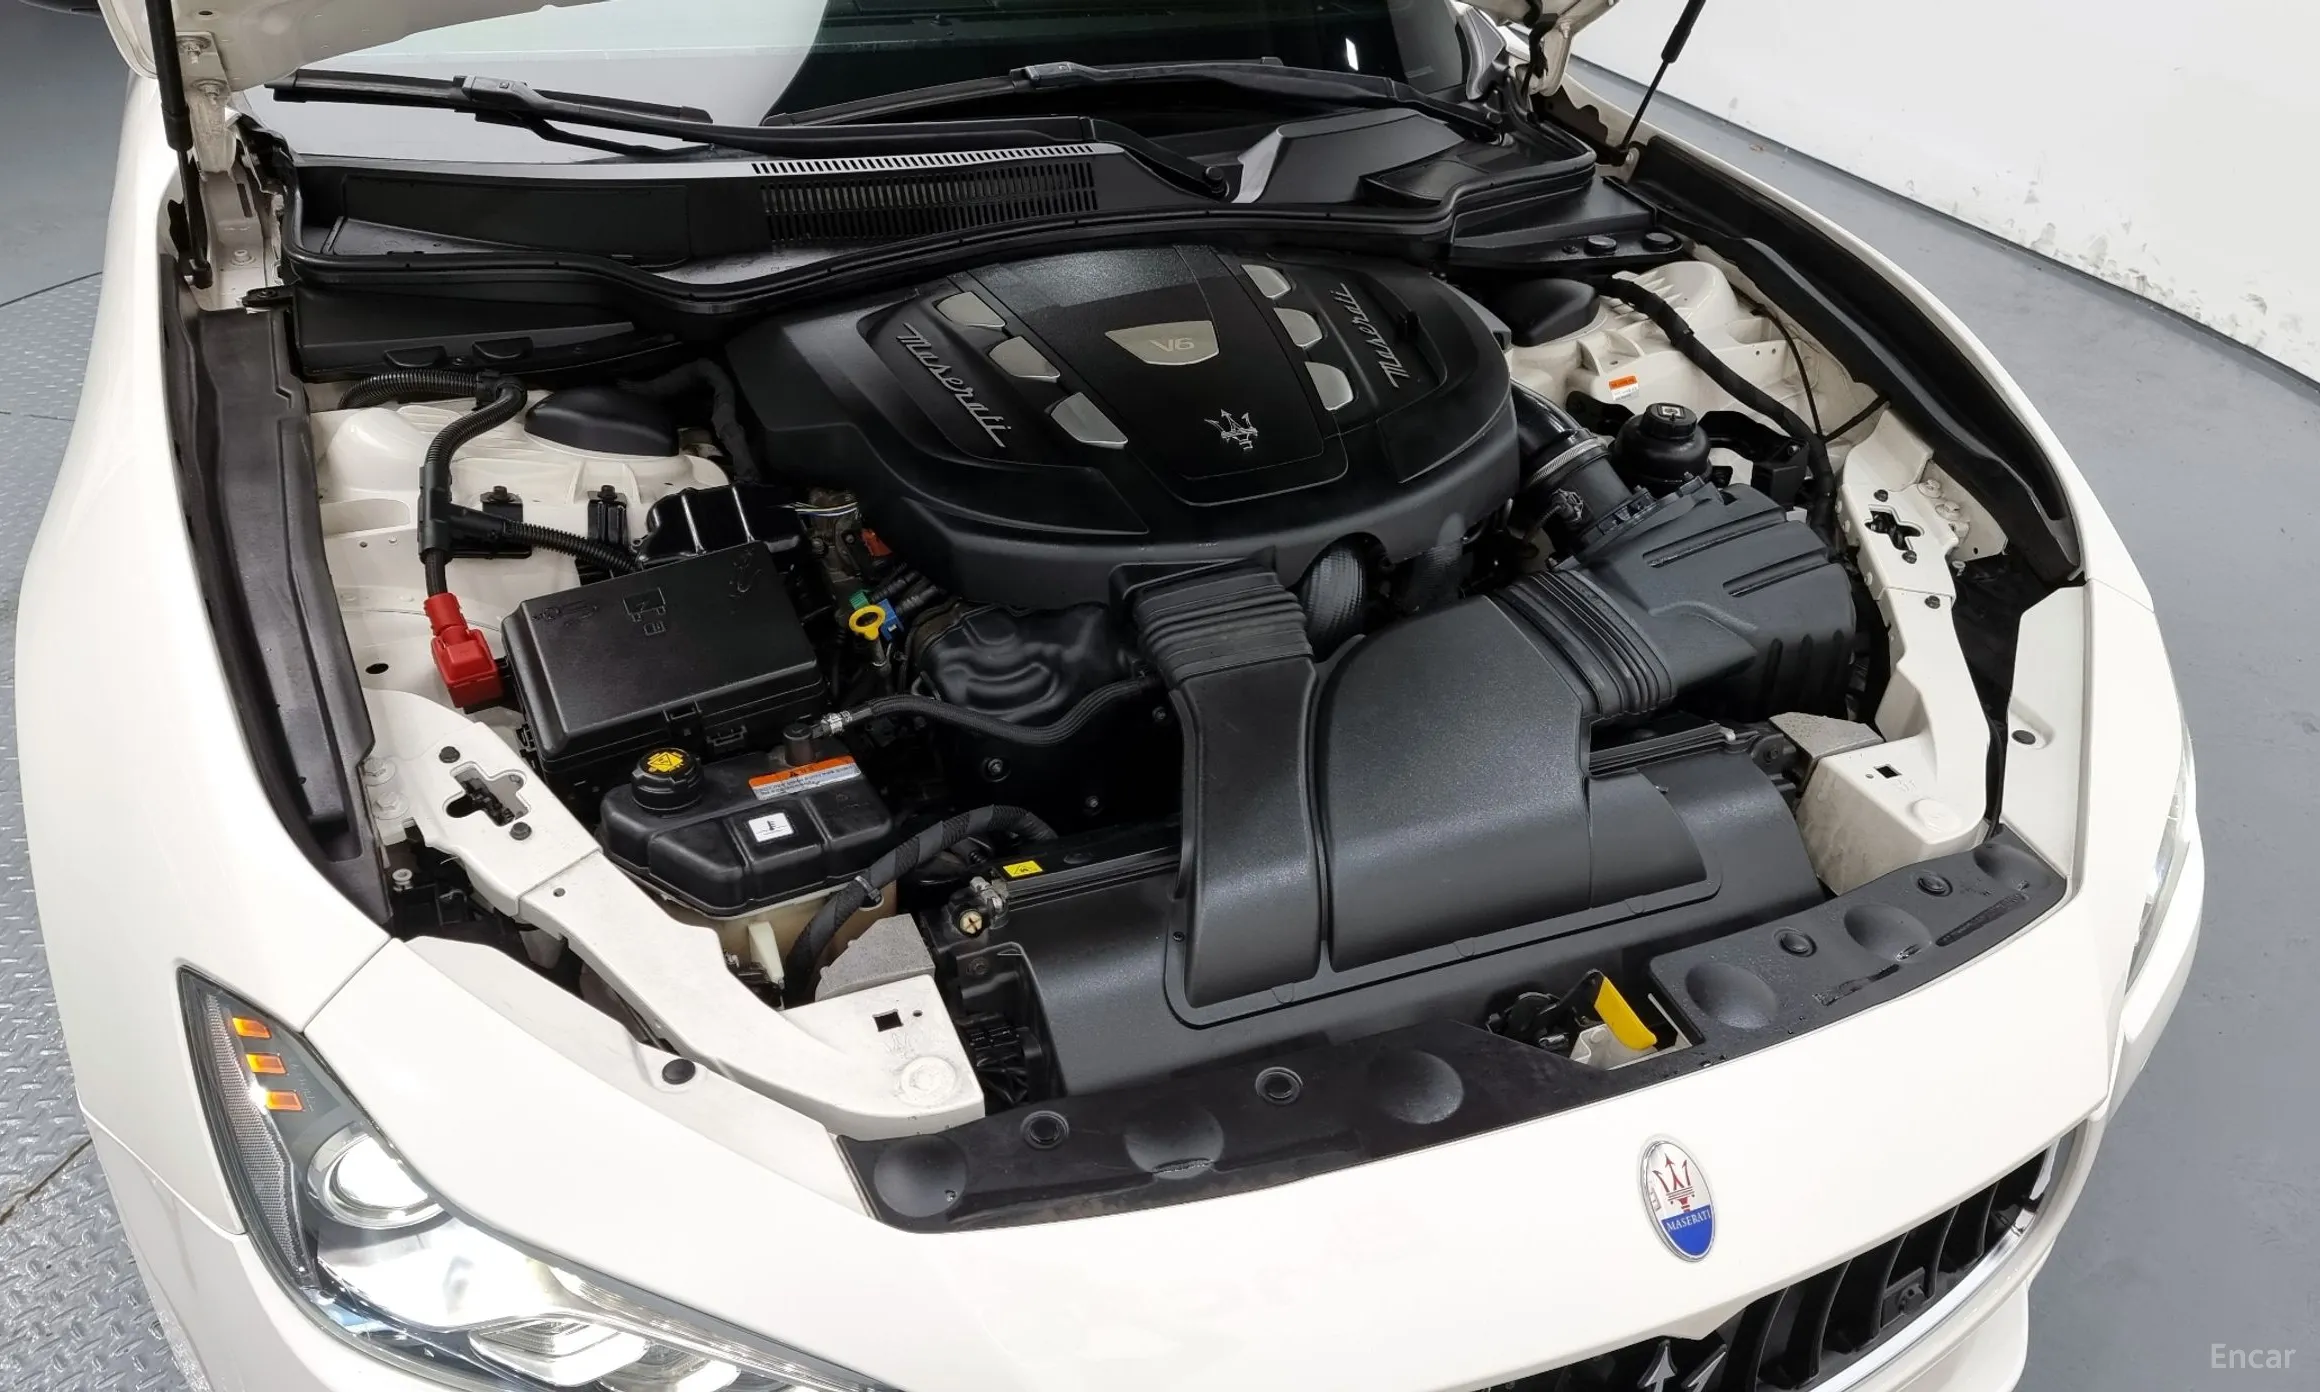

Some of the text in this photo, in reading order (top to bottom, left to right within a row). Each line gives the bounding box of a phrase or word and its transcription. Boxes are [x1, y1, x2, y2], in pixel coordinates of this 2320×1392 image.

[1149, 337, 1195, 352] V6
[1330, 282, 1411, 389] Maserati
[896, 322, 1012, 448] Maserati
[1666, 1209, 1711, 1232] MASERATI
